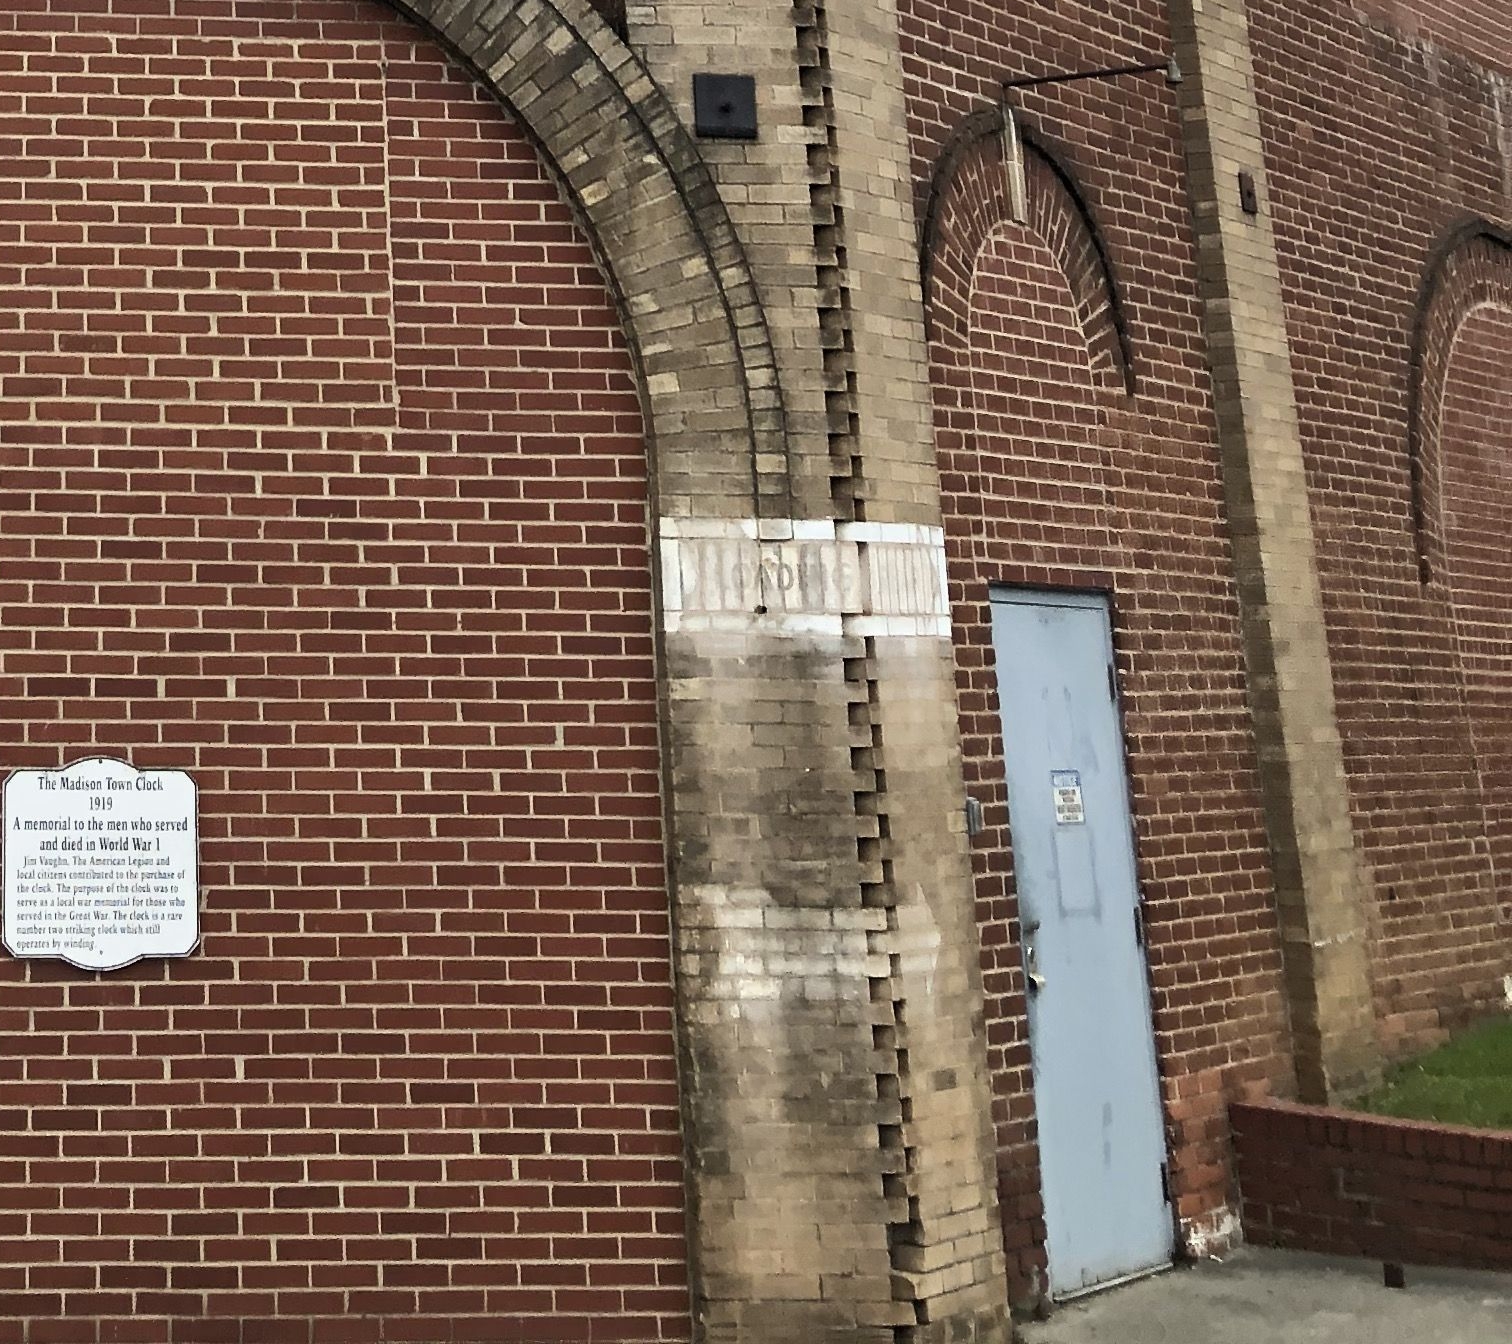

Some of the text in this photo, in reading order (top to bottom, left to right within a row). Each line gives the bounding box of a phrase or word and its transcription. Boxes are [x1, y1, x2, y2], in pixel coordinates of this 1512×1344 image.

[38, 777, 163, 791] The Madison Town Clock
[89, 796, 113, 810] 1919
[13, 816, 188, 831] A memorial to the men who served
[40, 837, 58, 851] and
[61, 836, 83, 851] died
[86, 836, 96, 851] in
[99, 837, 128, 851] World
[132, 837, 151, 851] War
[23, 856, 36, 868] Jim
[72, 856, 86, 866] The
[90, 856, 125, 866] American
[128, 856, 153, 868] Legion
[156, 856, 170, 866] and
[17, 870, 35, 879] local
[37, 870, 67, 879] citizens
[69, 870, 113, 879] contributed
[127, 870, 138, 879] the
[141, 870, 174, 881] purchase
[177, 870, 185, 879] of
[17, 883, 29, 893] the
[56, 883, 71, 893] The
[73, 886, 104, 895] purpose
[106, 883, 114, 893] of
[116, 883, 129, 893] the
[131, 883, 151, 893] clock
[171, 885, 178, 893] to
[57, 897, 75, 906] local
[94, 897, 130, 906] memorial
[132, 897, 143, 906] for
[145, 897, 166, 906] those
[169, 897, 185, 906] who
[17, 911, 42, 921] served
[45, 911, 52, 921] in
[54, 911, 66, 921] the
[69, 911, 91, 921] Great
[113, 911, 127, 921] The
[129, 911, 149, 921] clock
[168, 913, 183, 921] rare
[17, 924, 46, 934] number
[65, 924, 96, 937] striking
[98, 924, 117, 934] clock
[120, 924, 143, 934] which
[146, 924, 160, 934] still
[17, 941, 49, 951] operates
[52, 938, 60, 950] by
